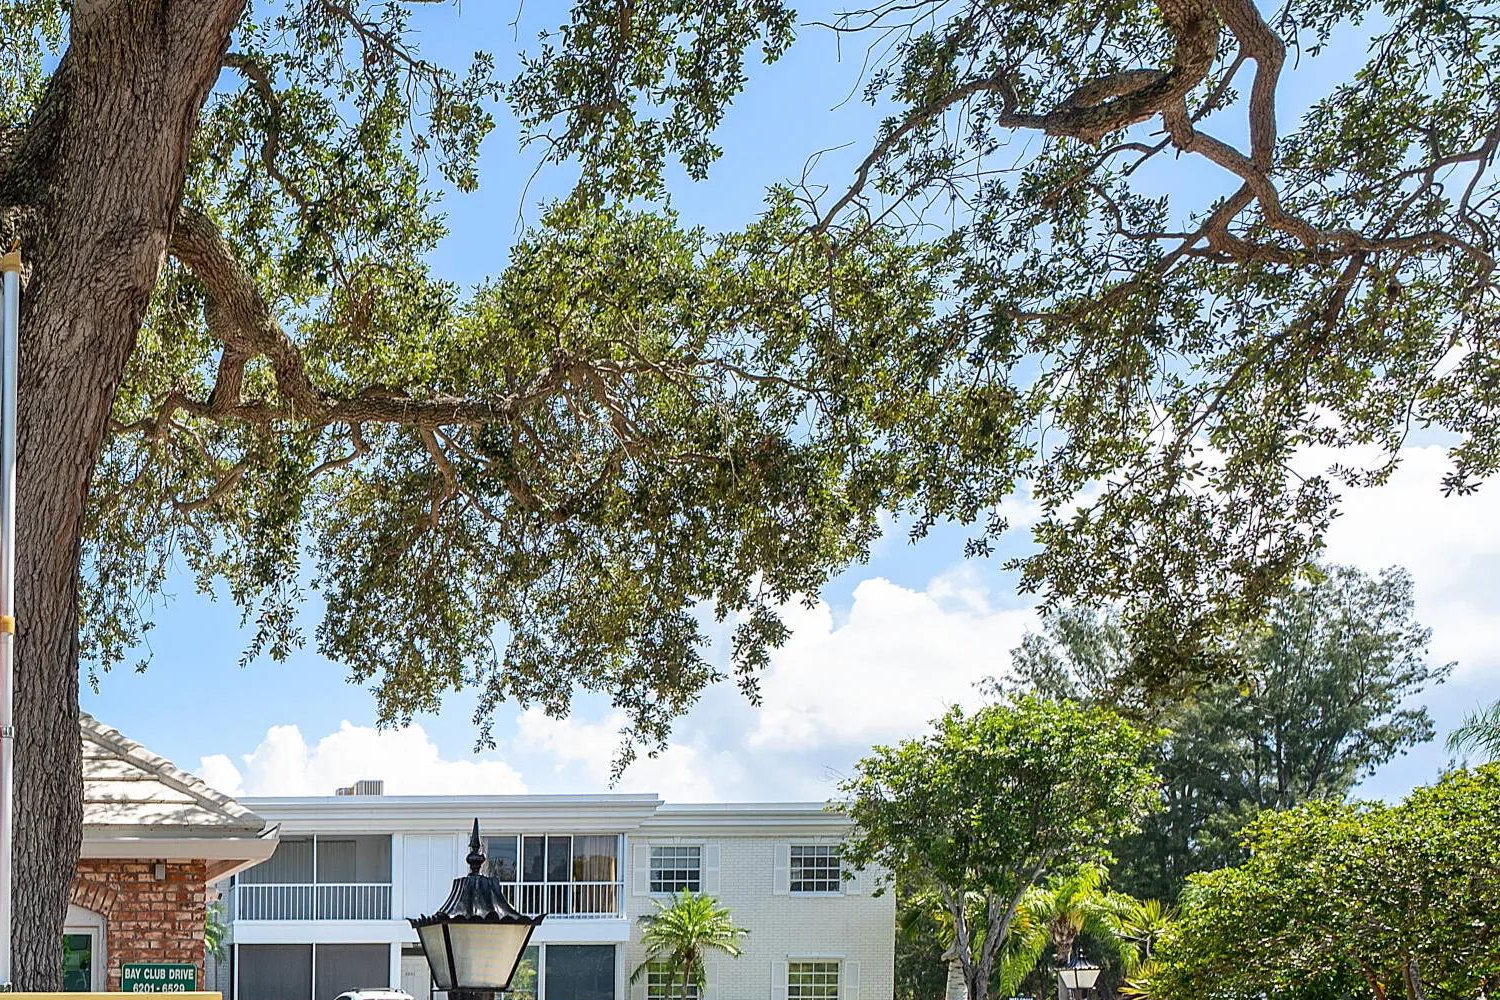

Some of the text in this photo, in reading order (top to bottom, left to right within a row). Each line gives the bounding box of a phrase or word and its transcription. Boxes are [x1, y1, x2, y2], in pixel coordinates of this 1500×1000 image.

[125, 968, 194, 980] BAY CLUB DRIVE
[133, 983, 155, 992] 6201
[162, 983, 185, 992] 6529
